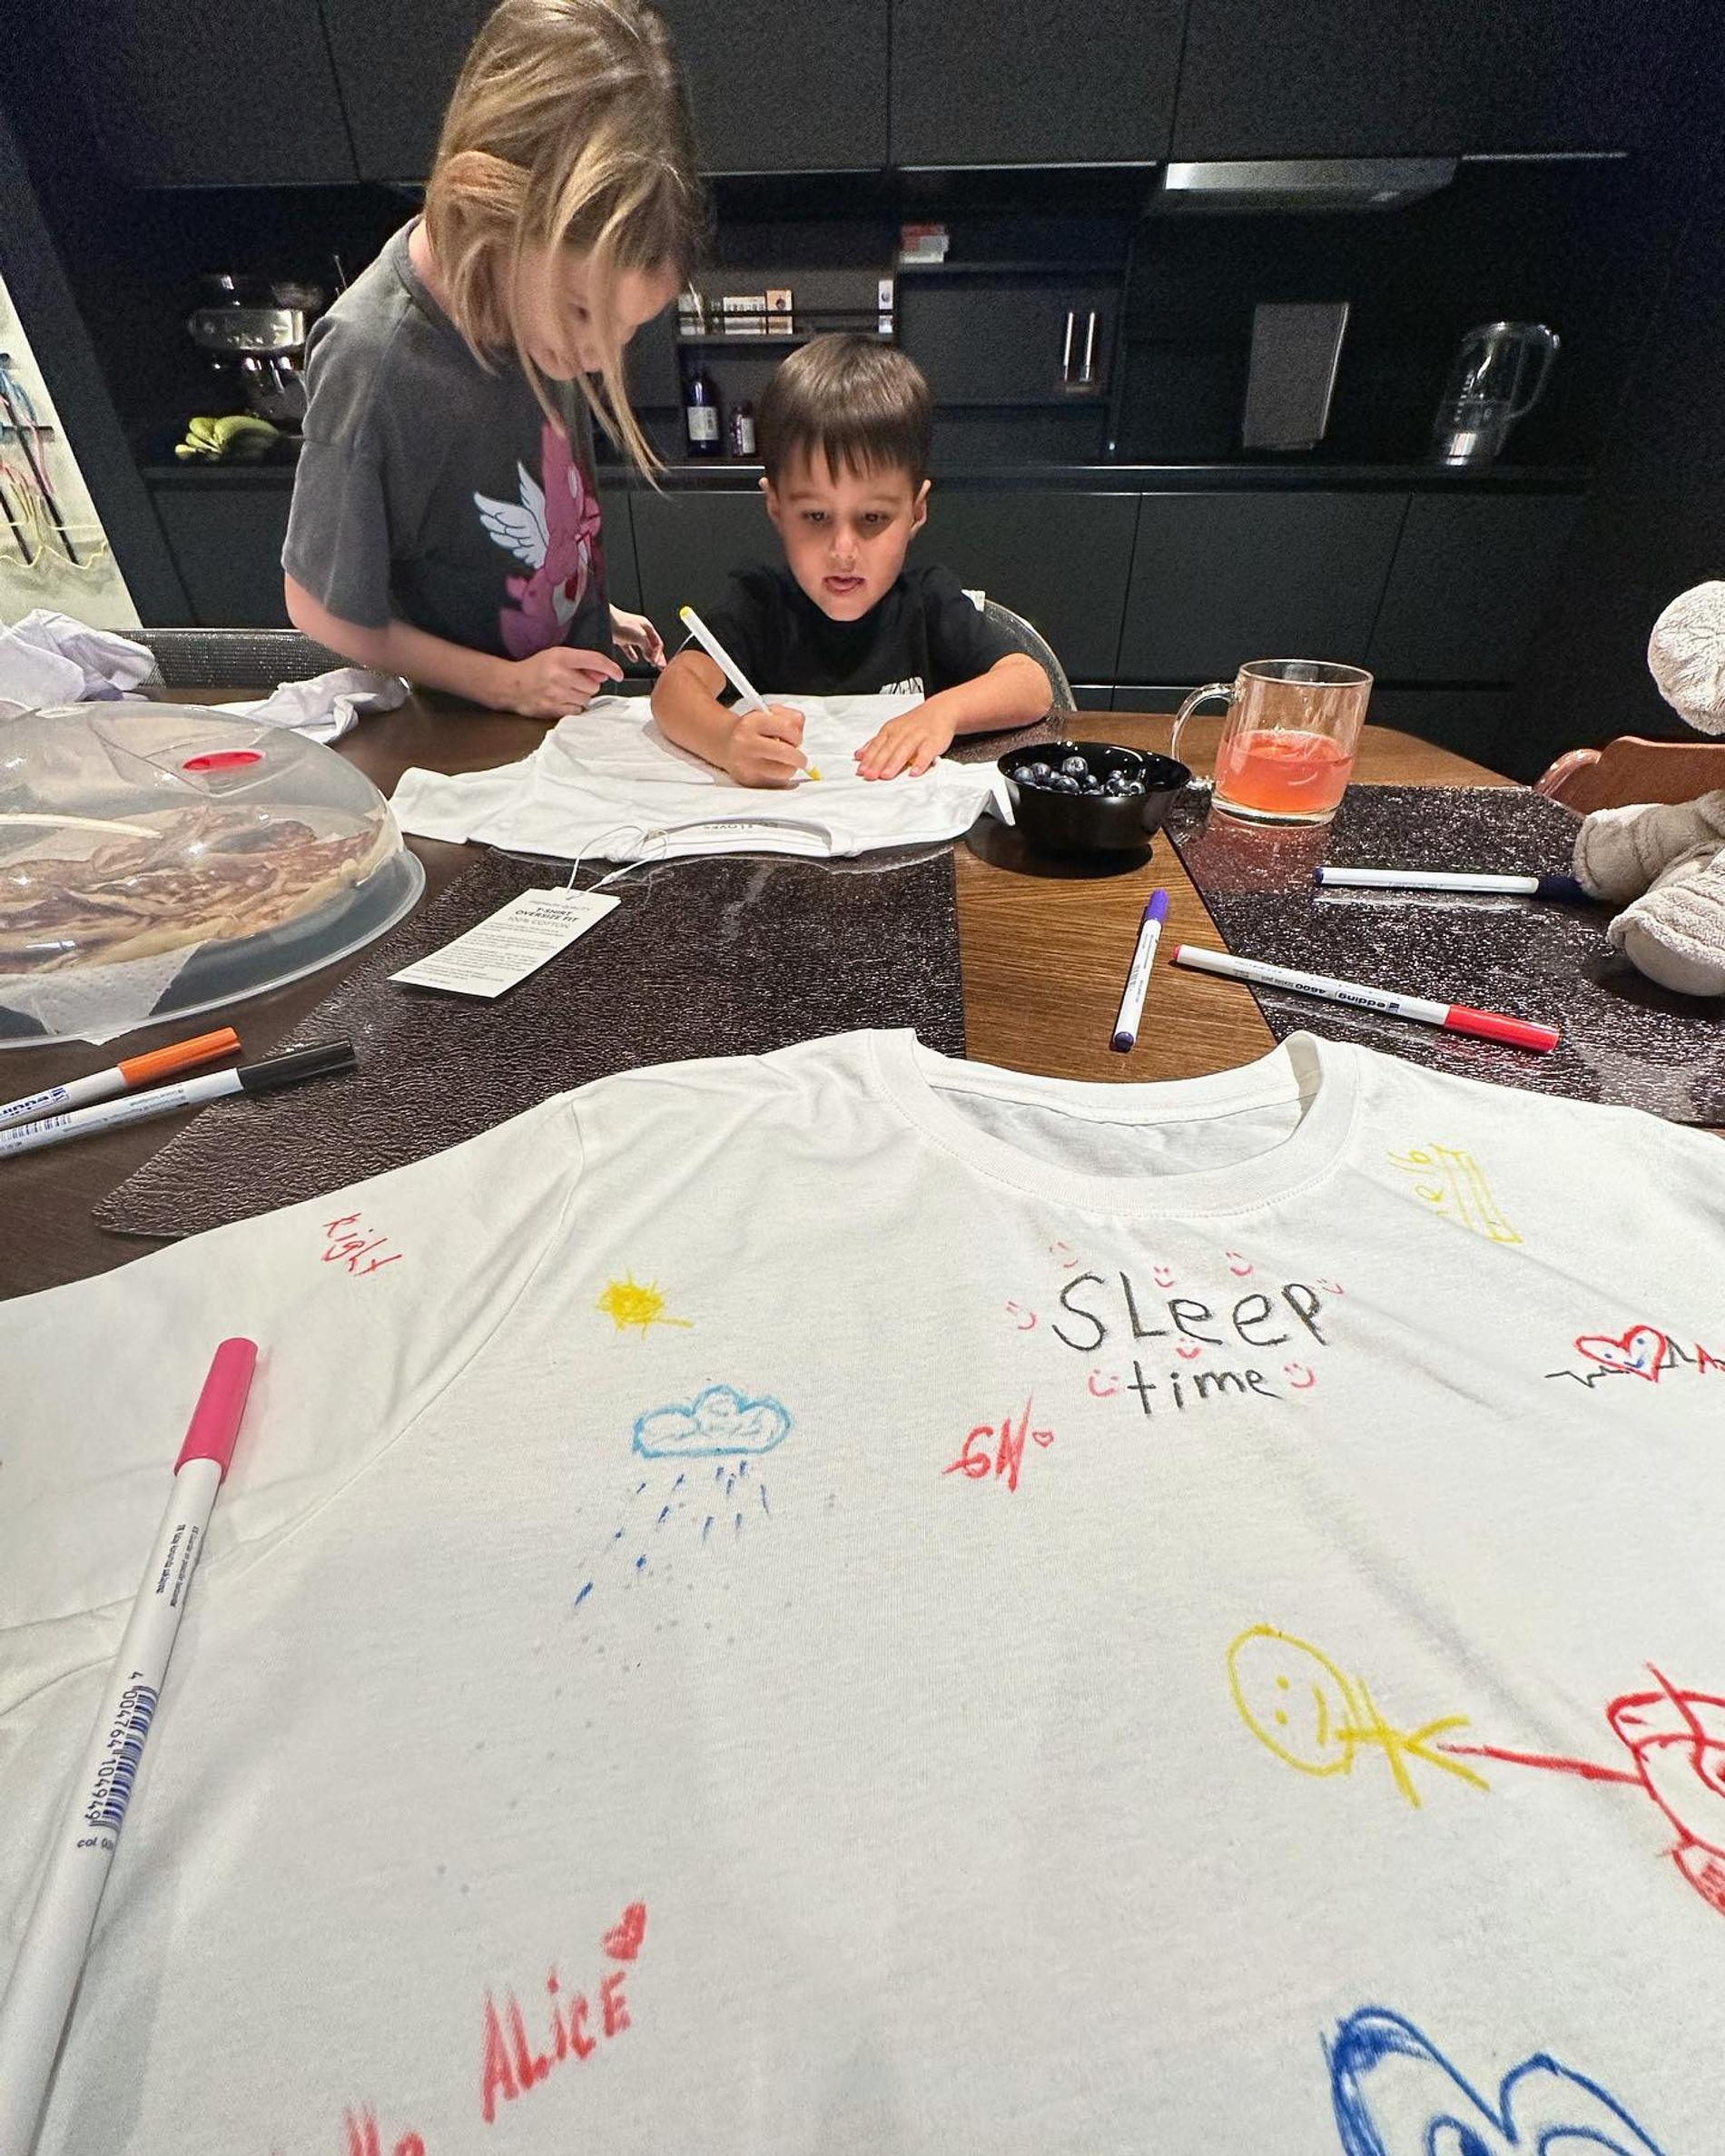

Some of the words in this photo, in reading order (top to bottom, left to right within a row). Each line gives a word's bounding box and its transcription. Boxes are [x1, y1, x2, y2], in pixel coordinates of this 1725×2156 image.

[516, 910, 561, 920] OVERSIZE
[537, 908, 573, 916] T-SHIRT
[531, 919, 570, 929] COTTON
[1337, 992, 1386, 1009] edding
[1127, 1360, 1284, 1415] time
[131, 1670, 143, 1679] 4
[106, 1689, 138, 1749] 004764
[84, 1758, 117, 1821] 104949
[77, 1836, 98, 1848] col
